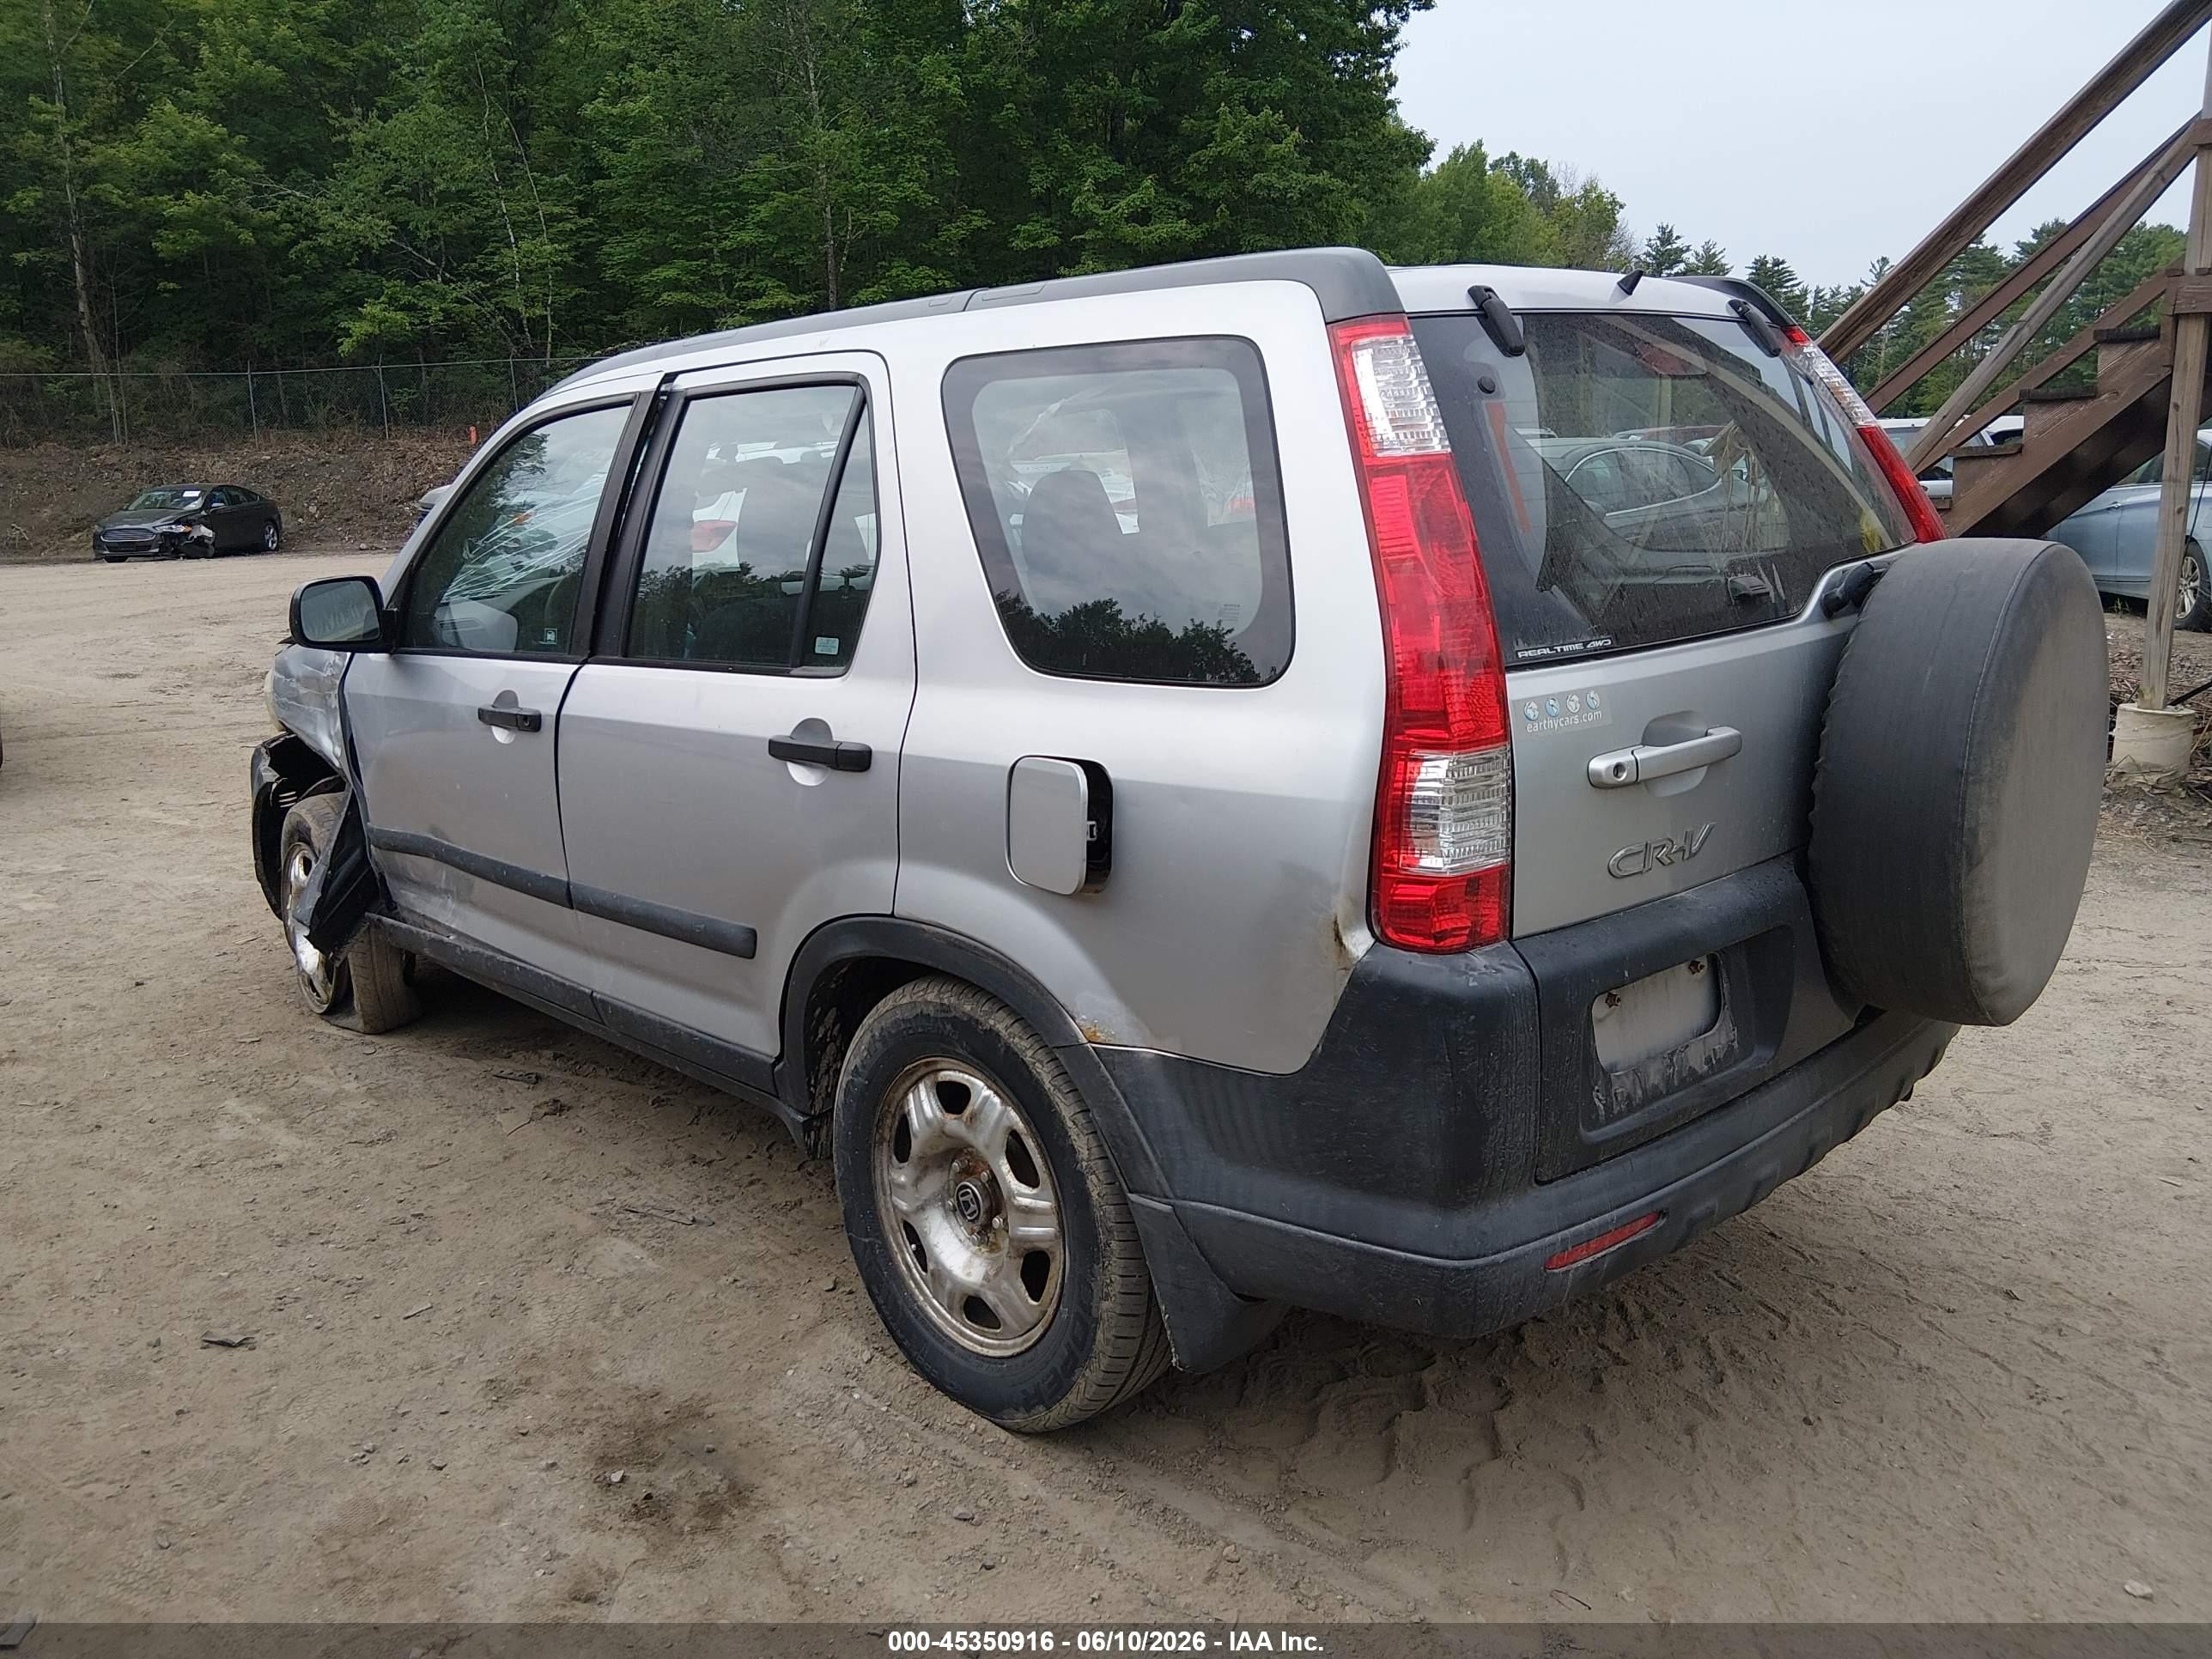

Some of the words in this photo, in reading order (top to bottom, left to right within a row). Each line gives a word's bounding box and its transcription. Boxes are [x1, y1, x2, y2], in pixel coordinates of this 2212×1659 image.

[1517, 644, 1584, 659] REALTIME
[1586, 638, 1612, 649] 4WD
[1526, 710, 1602, 732] earthycars.com
[1607, 822, 1716, 878] CR-V
